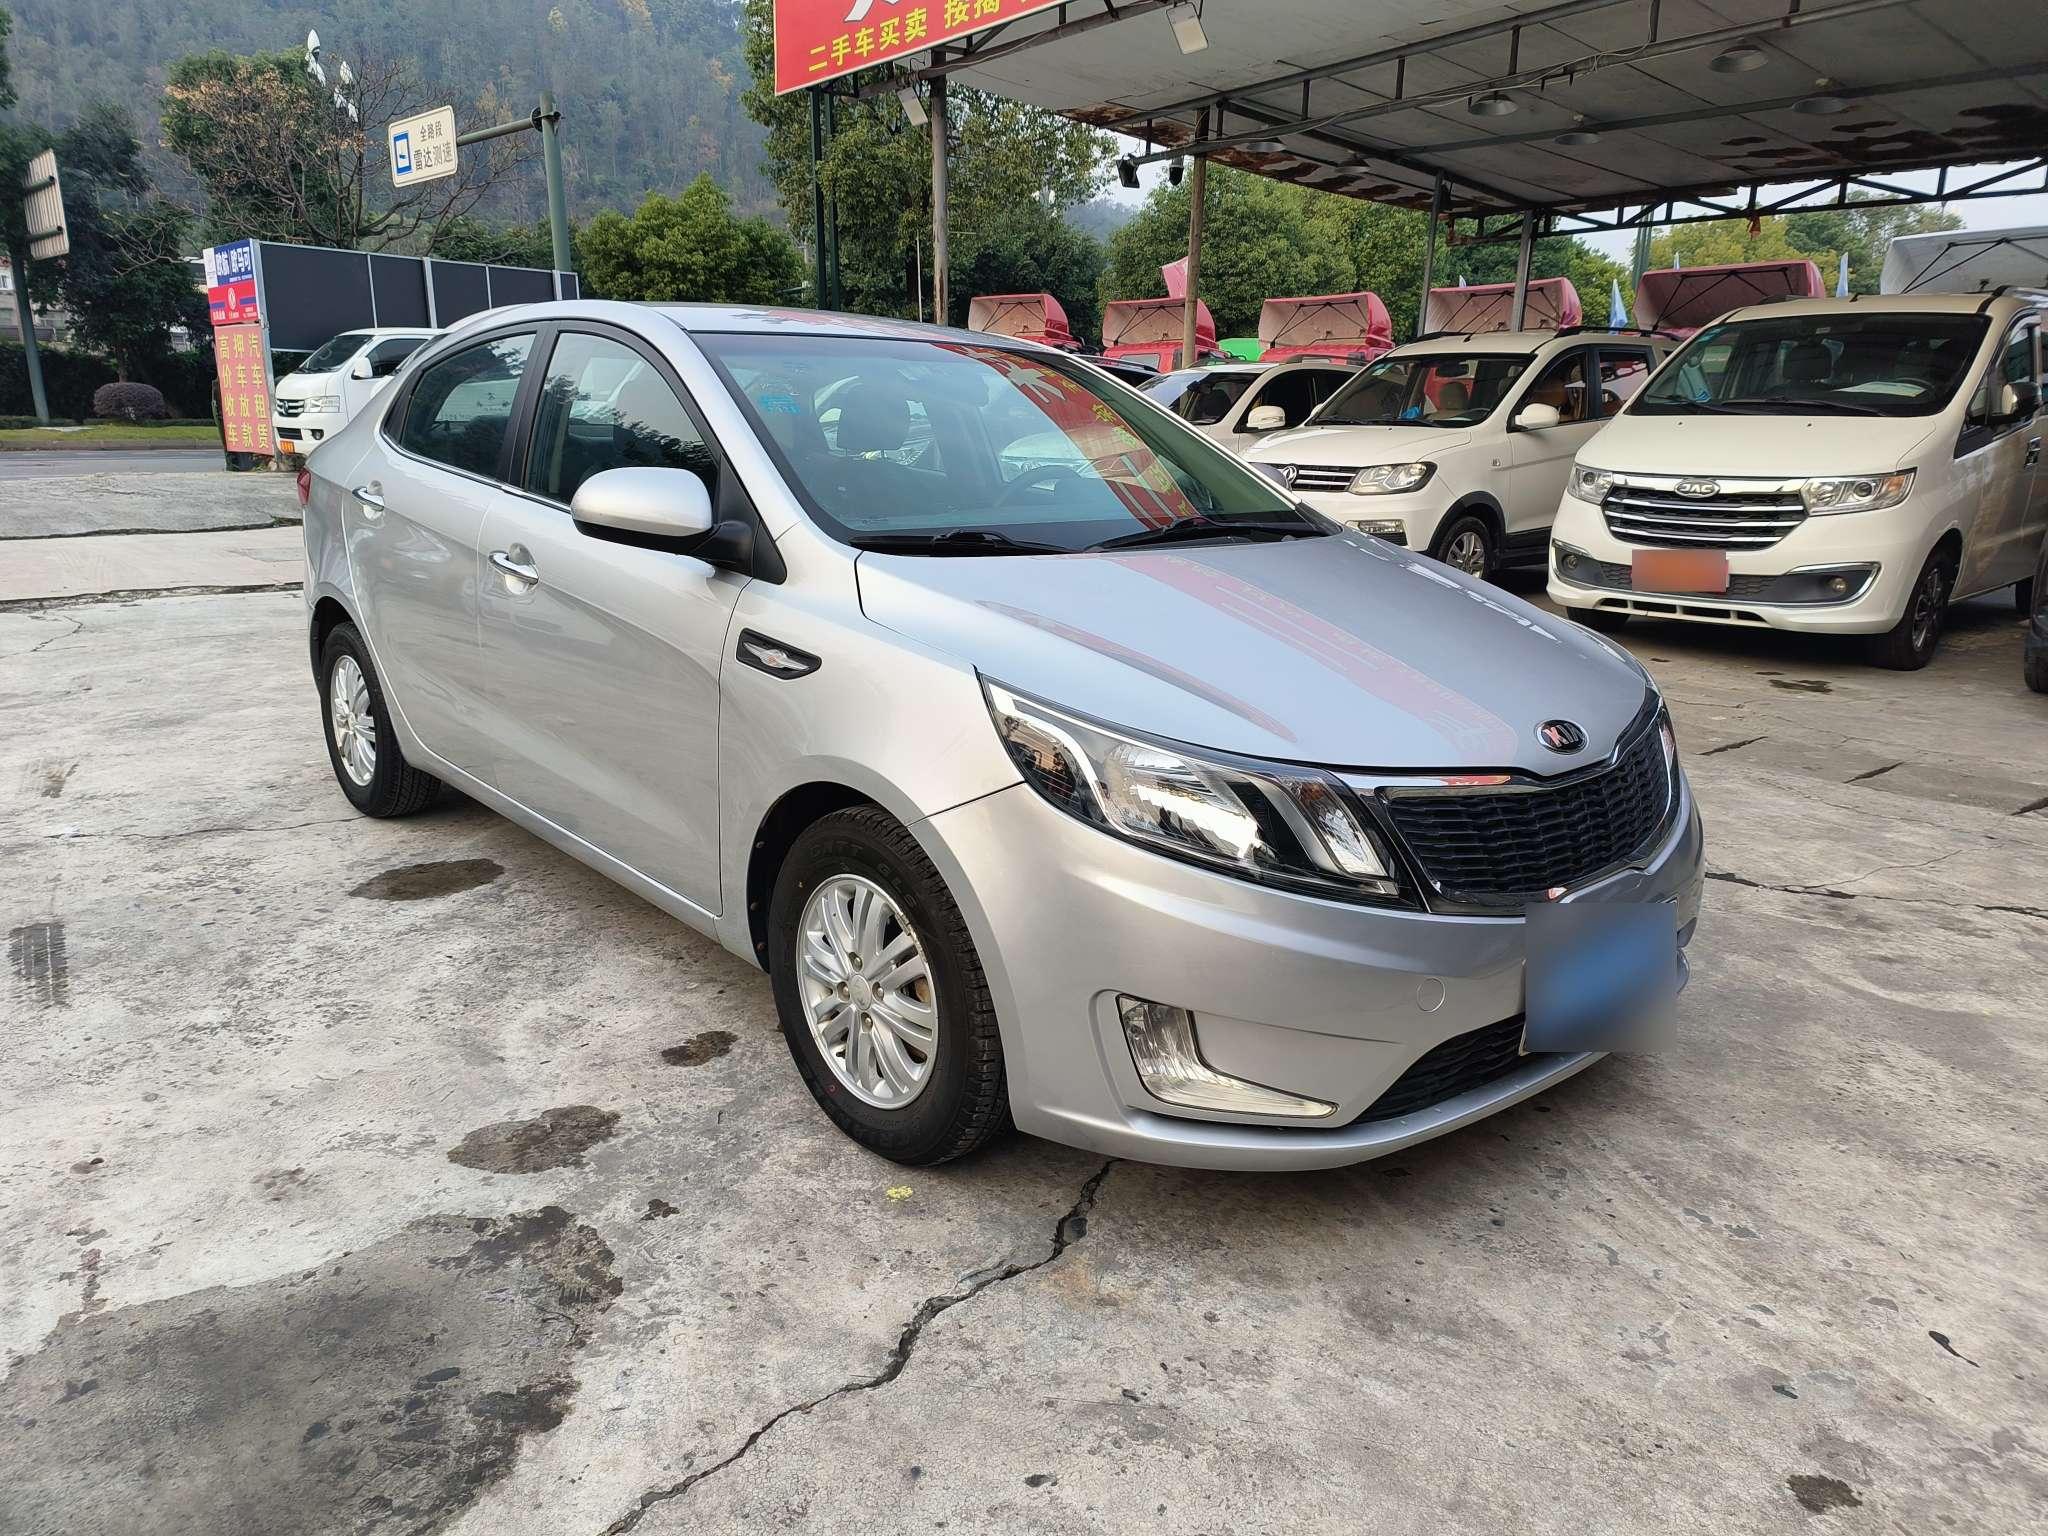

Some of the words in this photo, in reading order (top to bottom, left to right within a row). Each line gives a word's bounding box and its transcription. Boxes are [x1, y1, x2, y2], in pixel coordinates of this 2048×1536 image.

[808, 7, 928, 72] 二手车买卖
[413, 140, 453, 171] 雷达测速
[420, 120, 443, 142] 全路段
[218, 334, 239, 447] 高价收车
[233, 333, 254, 449] 押车放款
[247, 332, 270, 449] 汽车租赁
